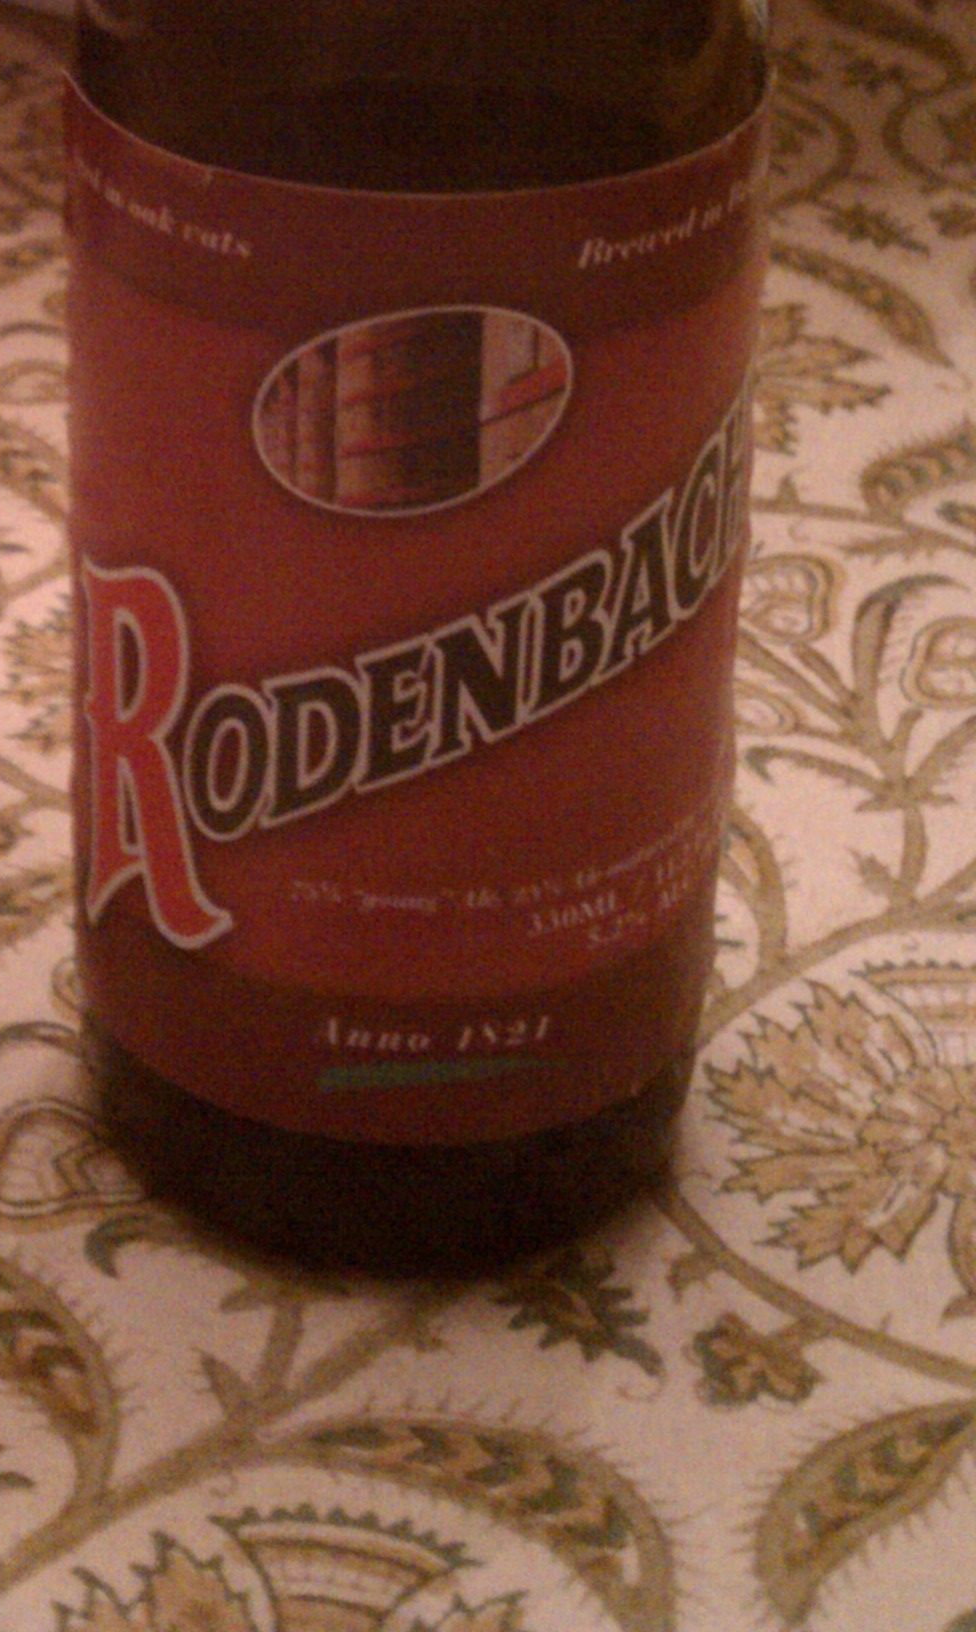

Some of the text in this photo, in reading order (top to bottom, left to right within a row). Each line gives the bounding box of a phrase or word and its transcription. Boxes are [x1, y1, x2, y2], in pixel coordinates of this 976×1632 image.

[578, 206, 697, 269] Brewed
[314, 1013, 551, 1053] Anno 1821
